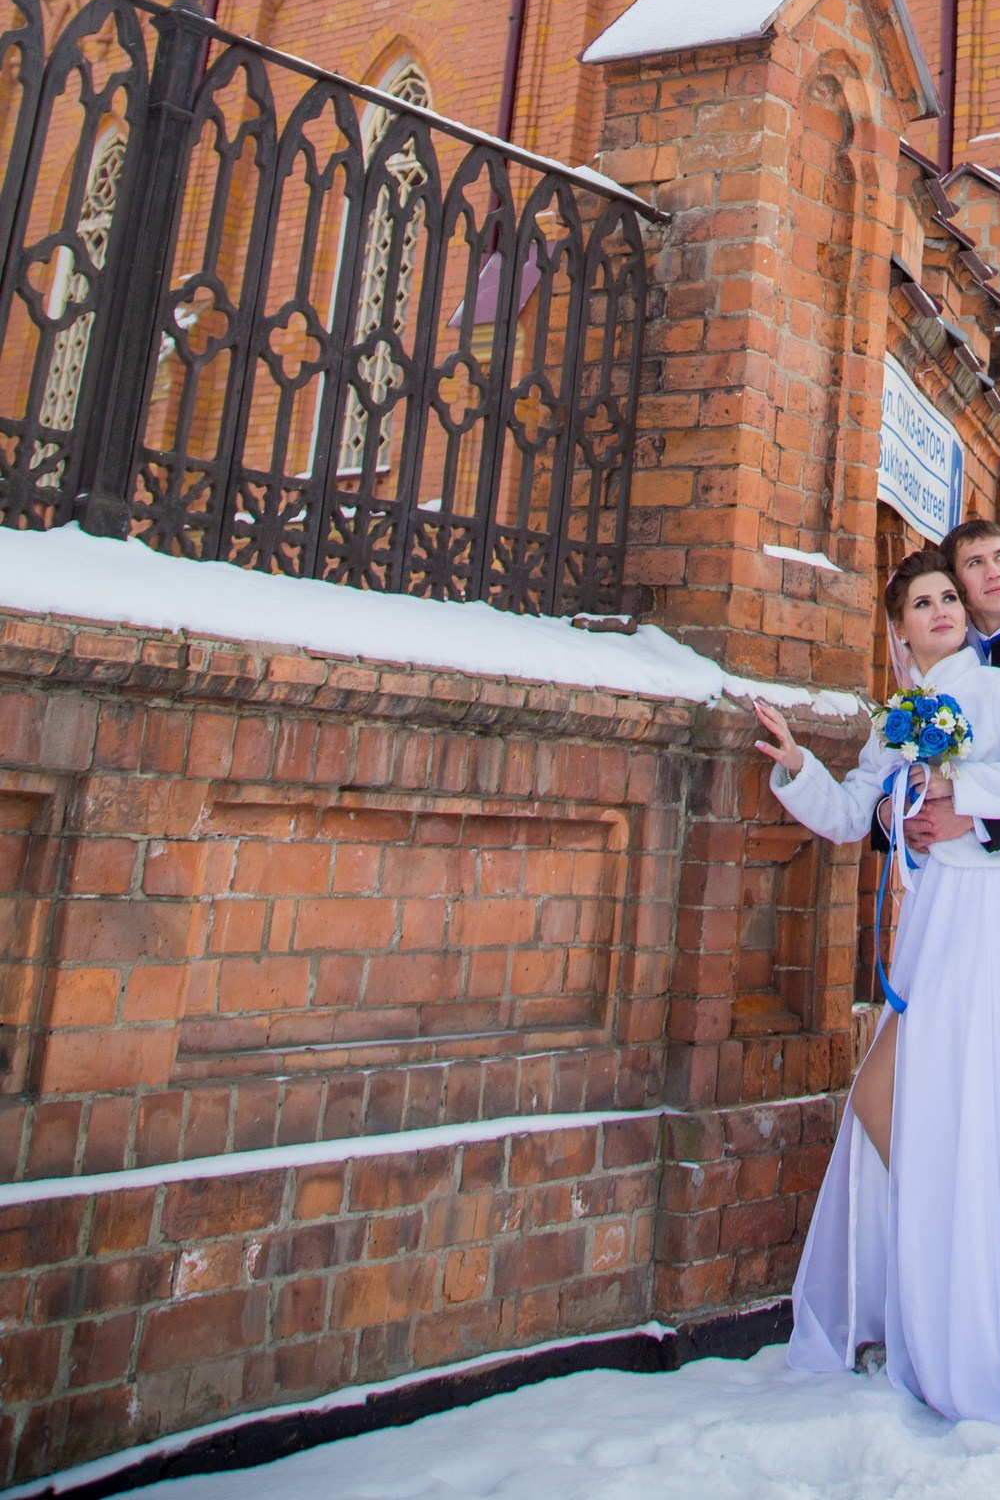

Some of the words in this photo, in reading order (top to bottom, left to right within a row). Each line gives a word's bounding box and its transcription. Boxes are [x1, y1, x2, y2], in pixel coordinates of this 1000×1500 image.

[897, 392, 946, 470] СУХЭ-БАТОРА
[922, 484, 946, 524] street
[953, 467, 960, 527] 1
